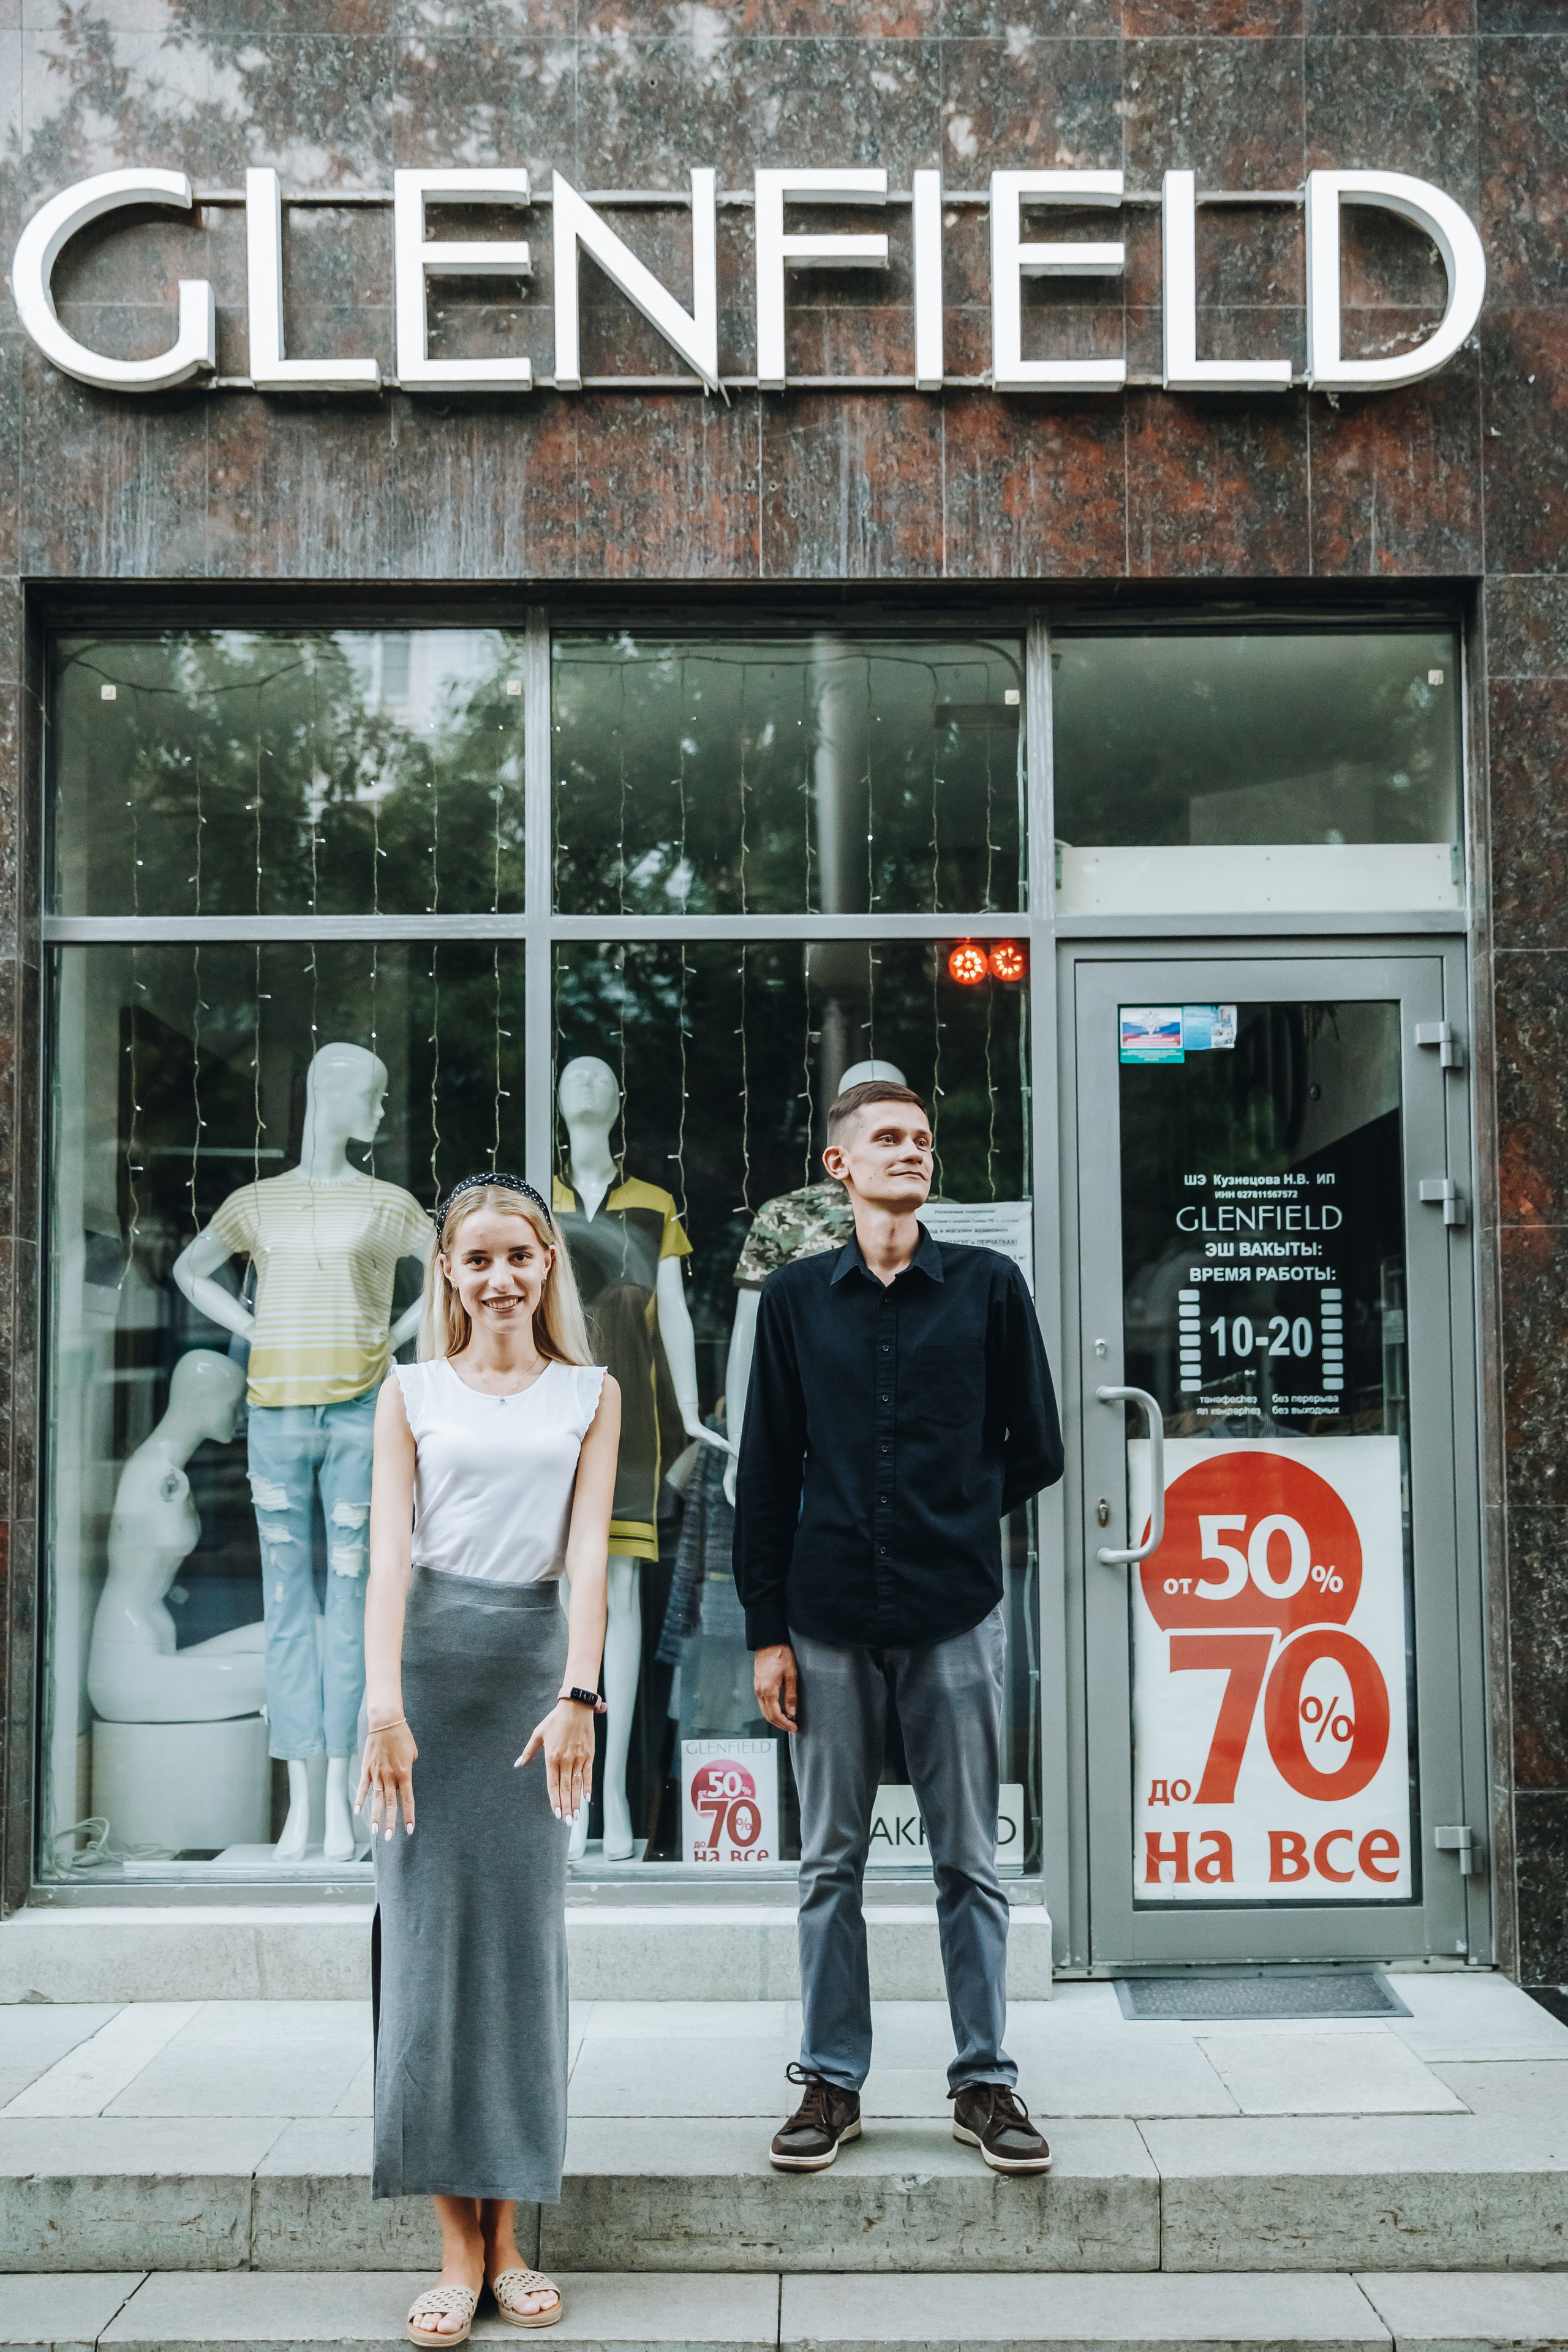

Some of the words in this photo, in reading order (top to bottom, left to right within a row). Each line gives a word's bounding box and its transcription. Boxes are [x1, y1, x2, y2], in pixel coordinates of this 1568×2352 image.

[12, 167, 1487, 393] GLENFIELD
[1184, 1174, 1207, 1186] ШЭ
[1213, 1174, 1281, 1188] Кузнецова
[1283, 1174, 1310, 1185] Н.В.
[1316, 1173, 1335, 1185] ИП
[1215, 1190, 1235, 1199] ИНН
[1176, 1205, 1343, 1232] GLENFIELD
[1205, 1242, 1234, 1257] ЭШ
[1189, 1267, 1251, 1282] ВРЕМЯ
[1256, 1266, 1336, 1281] РАБОТЫ:
[1210, 1315, 1313, 1357] 10-20
[1272, 1393, 1289, 1403] без
[1291, 1395, 1340, 1404] перерыва
[1272, 1405, 1289, 1415] без
[1291, 1407, 1340, 1415] выходных
[1163, 1578, 1193, 1595] от
[685, 1740, 772, 1755] GLENFIELD
[1148, 1779, 1192, 1807] до
[693, 1850, 720, 1861] на
[730, 1849, 769, 1861] все
[1144, 1830, 1235, 1884] на
[1267, 1828, 1400, 1883] все
